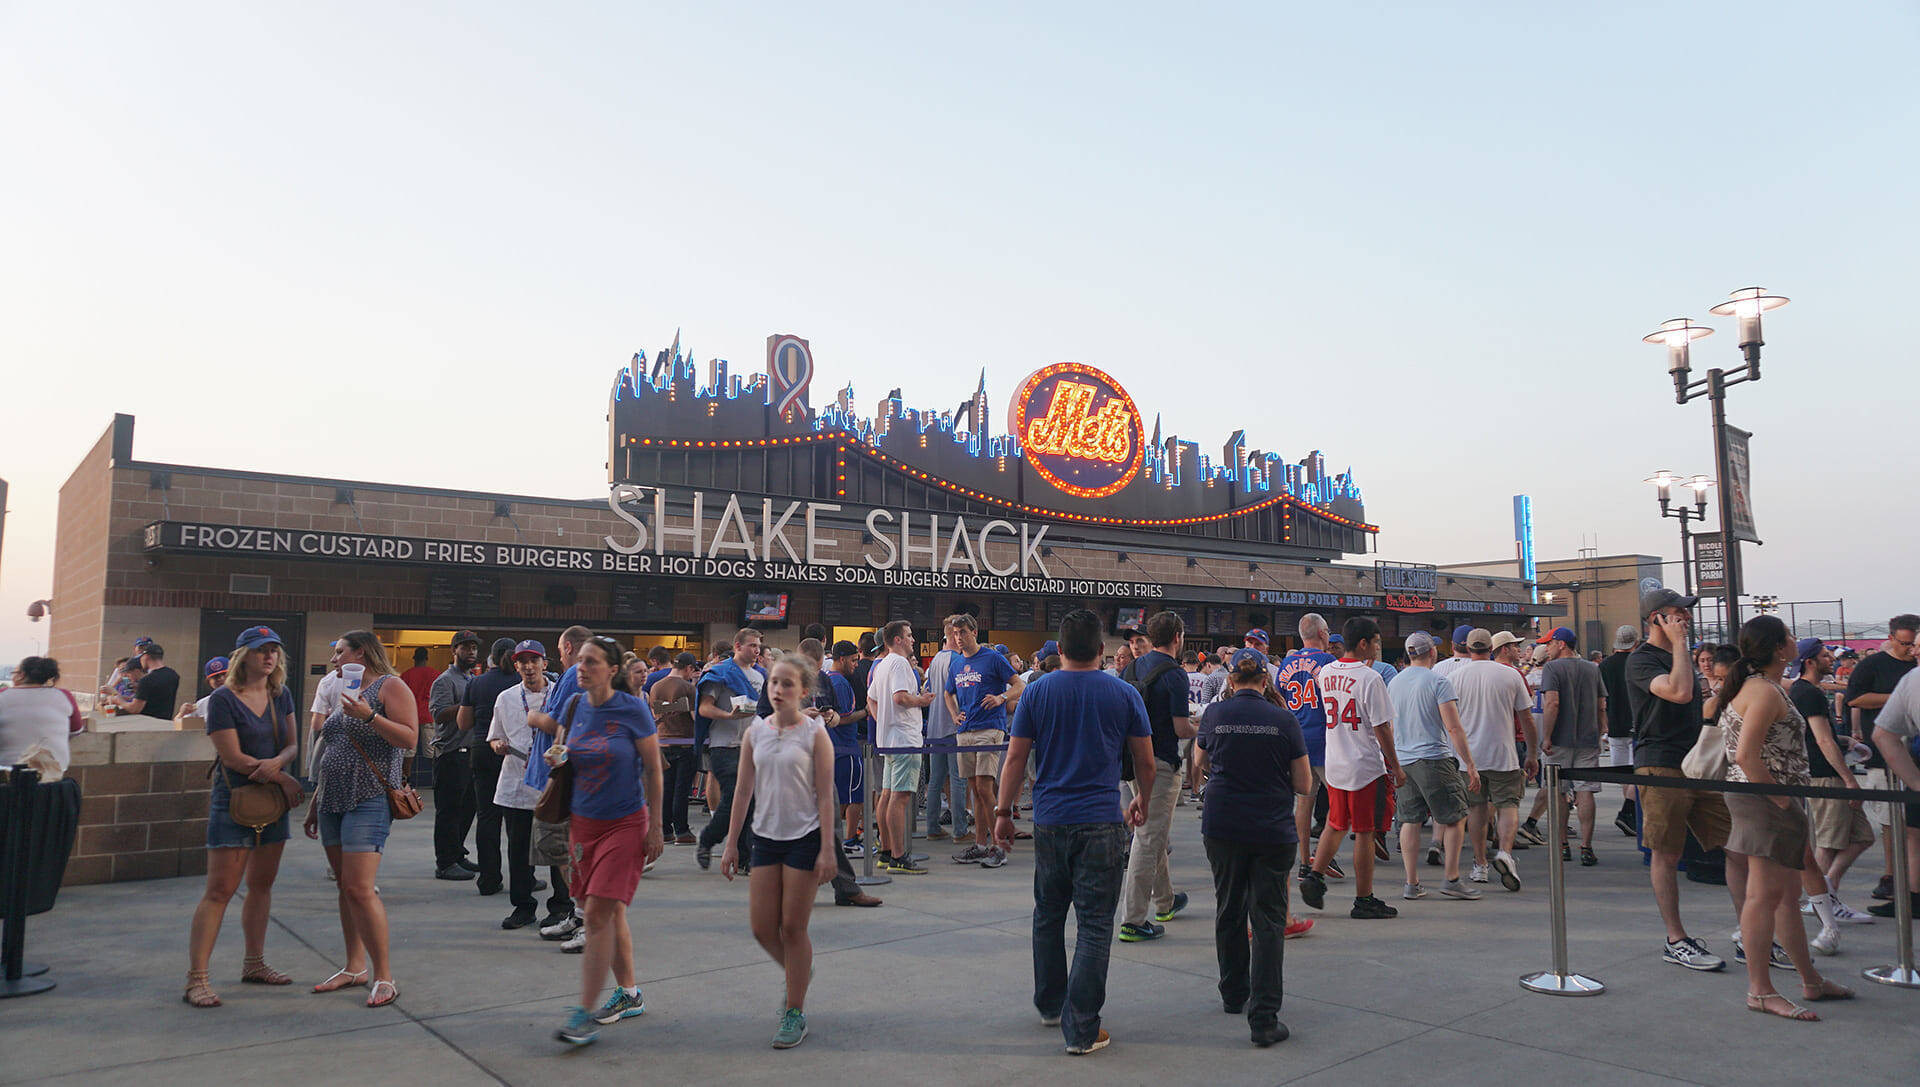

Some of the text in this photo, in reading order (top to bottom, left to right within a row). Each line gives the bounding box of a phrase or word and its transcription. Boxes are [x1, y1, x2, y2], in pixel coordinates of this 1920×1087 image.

[1028, 380, 1131, 463] Mets
[604, 485, 1050, 578] SHAKE SHACK
[180, 525, 1162, 597] FROZEN CUSTARD FRIES BURGERS BEER HOT DOGS SHAKES SODA BURGERS FROZEN CUSTARD HOT DOGS FRIES
[1384, 569, 1434, 588] BLUE SMOKE
[1259, 591, 1374, 607] PULLED PORK BRAT
[1446, 600, 1518, 613] BRISKET SIDES
[1287, 679, 1318, 710] 34
[1324, 675, 1356, 694] ORTIZ
[1324, 696, 1362, 731] 34
[1215, 724, 1279, 736] SUPERVISOR
